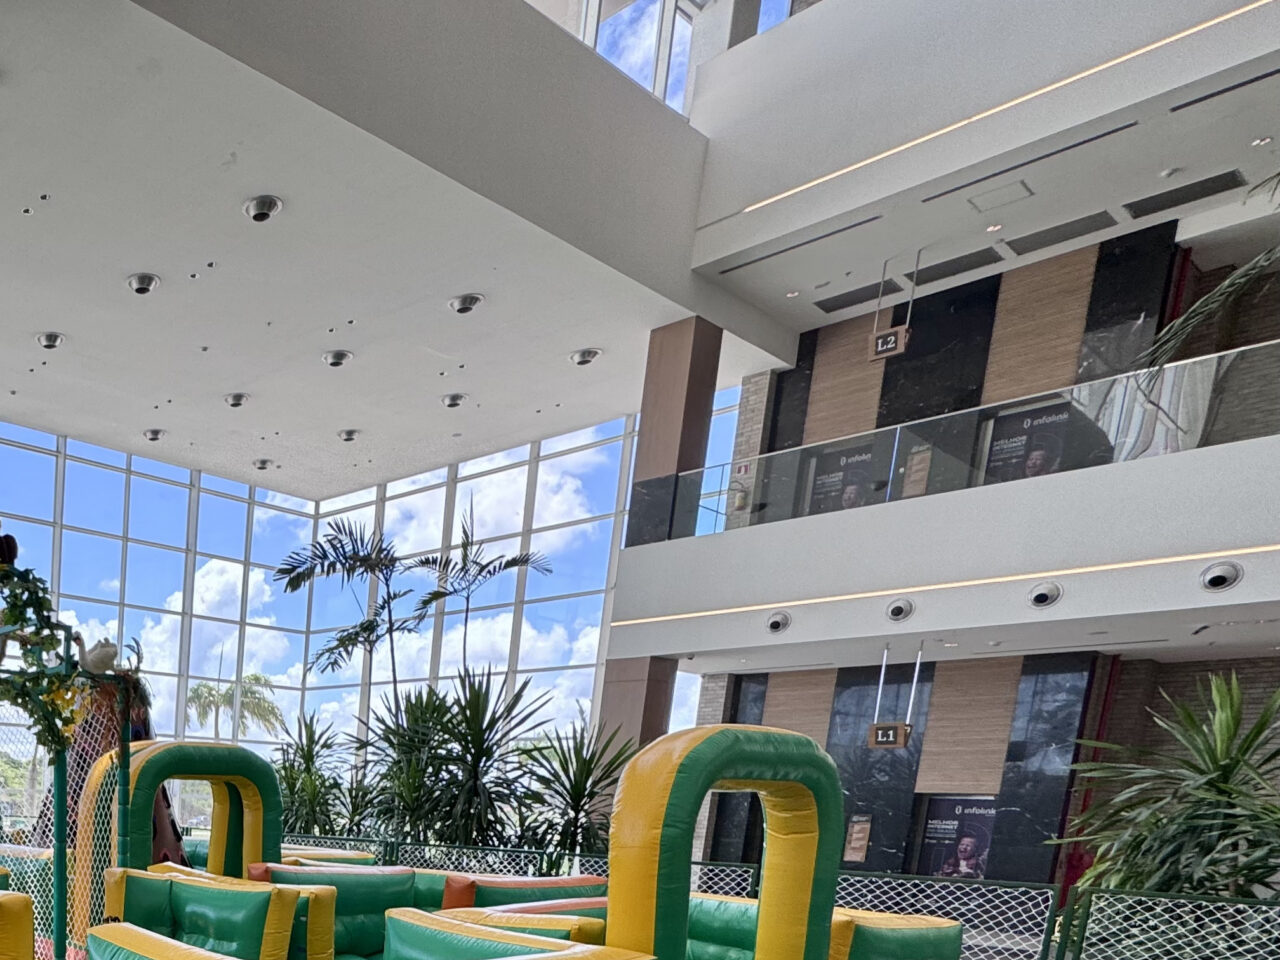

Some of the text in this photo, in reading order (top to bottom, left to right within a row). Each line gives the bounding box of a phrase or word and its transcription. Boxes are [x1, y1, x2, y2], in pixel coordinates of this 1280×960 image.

[877, 336, 896, 352] L2
[877, 730, 895, 741] L1
[964, 807, 997, 815] infolink
